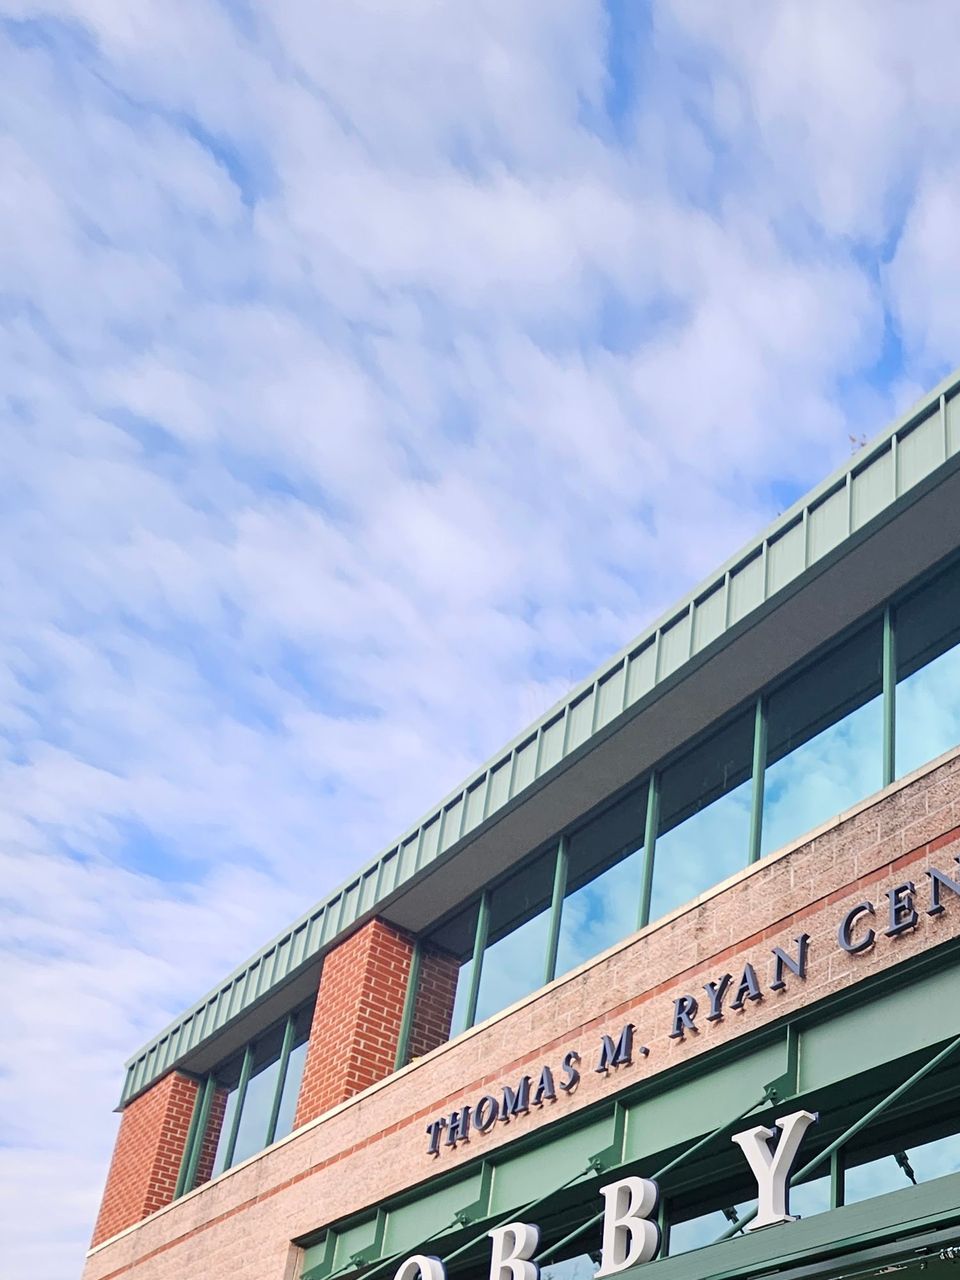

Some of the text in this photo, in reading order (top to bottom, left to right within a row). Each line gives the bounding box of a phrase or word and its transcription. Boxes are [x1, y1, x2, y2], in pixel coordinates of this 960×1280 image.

[425, 1050, 582, 1156] THOMAS
[595, 1023, 650, 1075] M.
[669, 933, 811, 1040] RYAN
